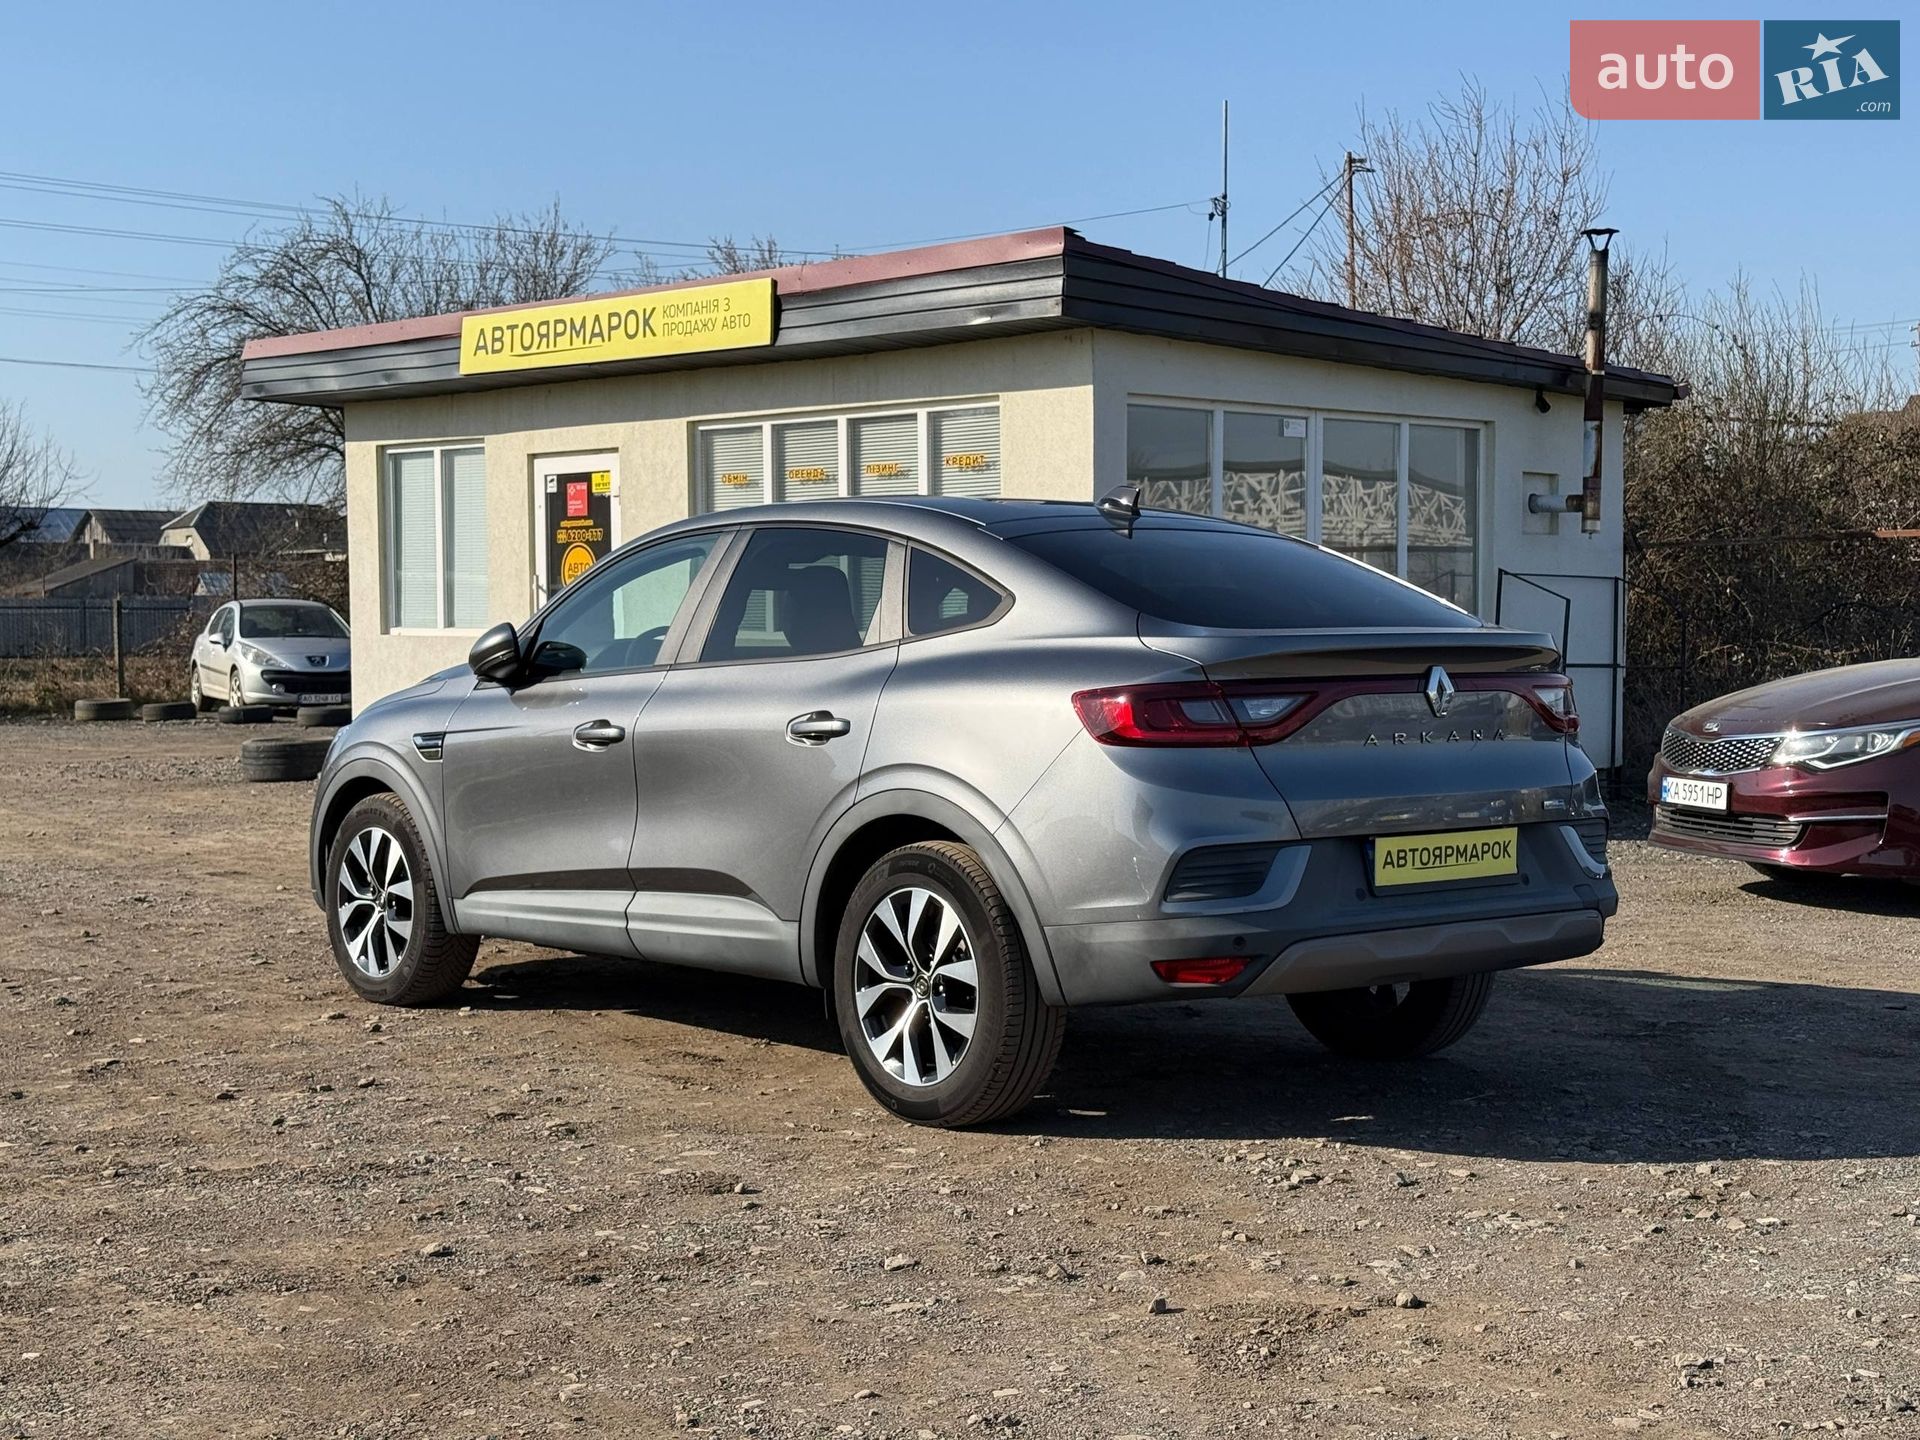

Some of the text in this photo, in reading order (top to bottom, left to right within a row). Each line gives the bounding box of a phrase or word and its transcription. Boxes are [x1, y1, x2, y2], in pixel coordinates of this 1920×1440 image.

[662, 299, 719, 317] КОМПАНІЯ
[473, 307, 657, 357] АВТОЯРМАРОК
[662, 313, 751, 337] ПРОДАЖУ АВТО
[865, 463, 899, 475] ЛІЗИНГ
[945, 454, 986, 467] КРЕДИТ
[721, 474, 748, 485] ОБМІН
[788, 467, 826, 480] ОРЕНДА
[1364, 729, 1507, 746] ARKANA
[1667, 781, 1722, 806] KA 5951 HP
[1382, 839, 1512, 870] АВТОЯРМАРОК
